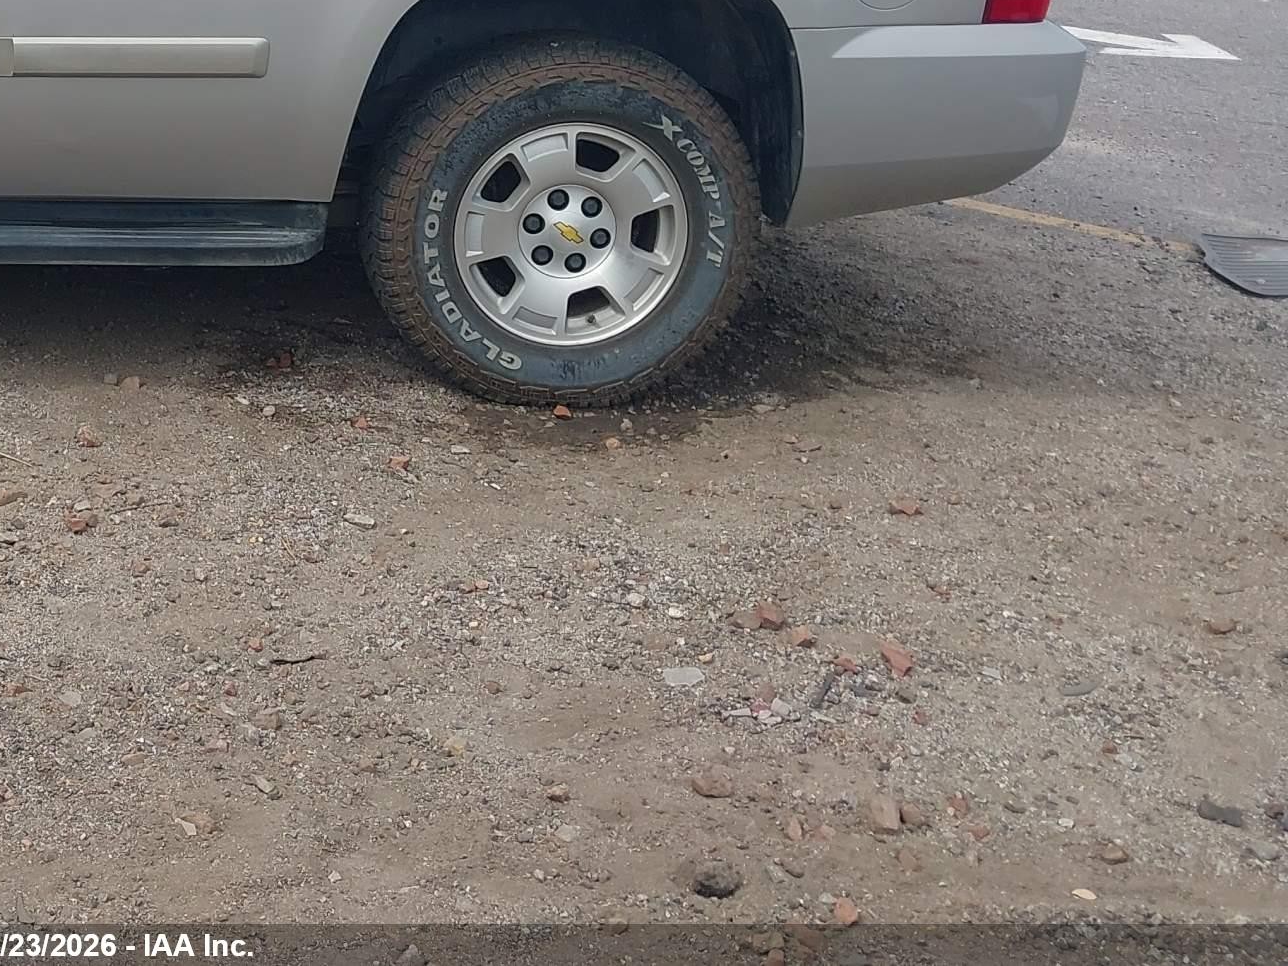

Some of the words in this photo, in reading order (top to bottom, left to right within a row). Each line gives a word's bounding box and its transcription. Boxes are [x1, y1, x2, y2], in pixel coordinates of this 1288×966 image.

[423, 189, 522, 370] GLADIATOR
[676, 138, 720, 199] COMP
[706, 210, 726, 268] A/T
